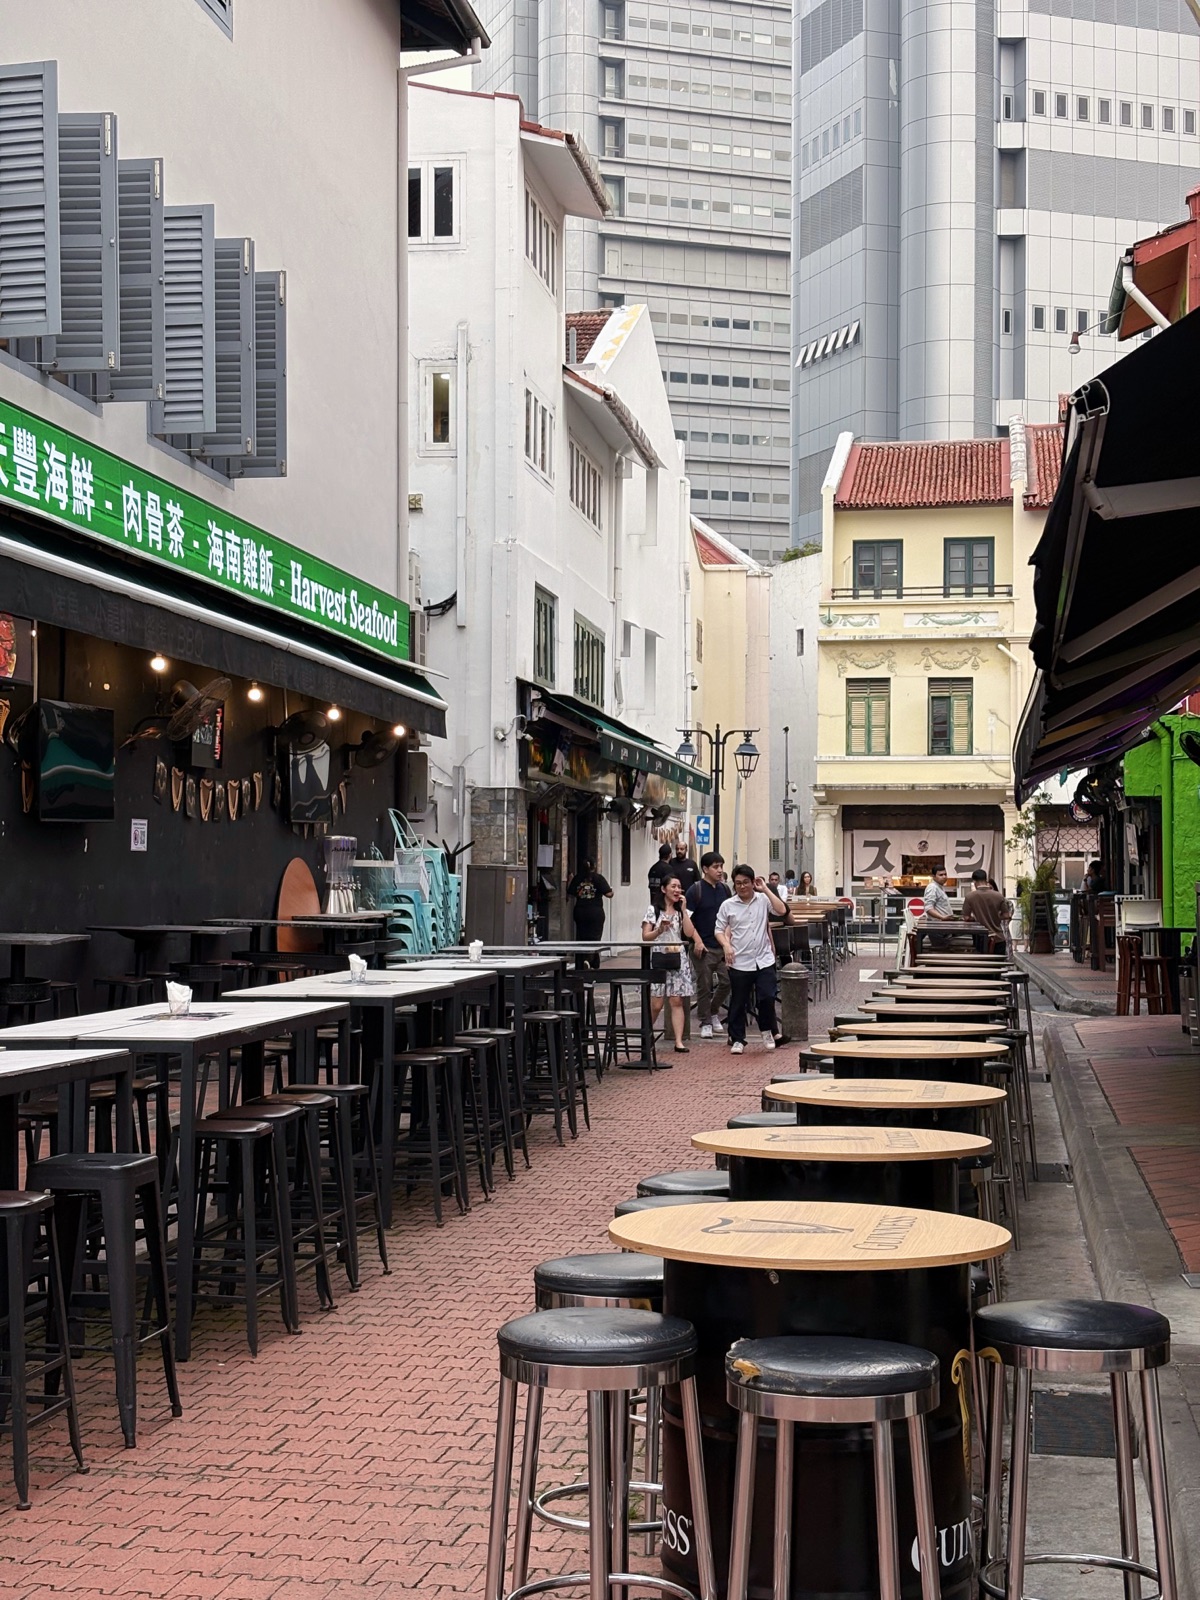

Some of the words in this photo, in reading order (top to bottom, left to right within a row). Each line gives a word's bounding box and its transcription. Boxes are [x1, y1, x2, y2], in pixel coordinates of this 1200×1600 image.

[122, 479, 185, 559] 肉骨茶
[290, 560, 347, 625] Harvest
[349, 589, 398, 647] Seafood
[852, 1214, 918, 1251] GUINNESS
